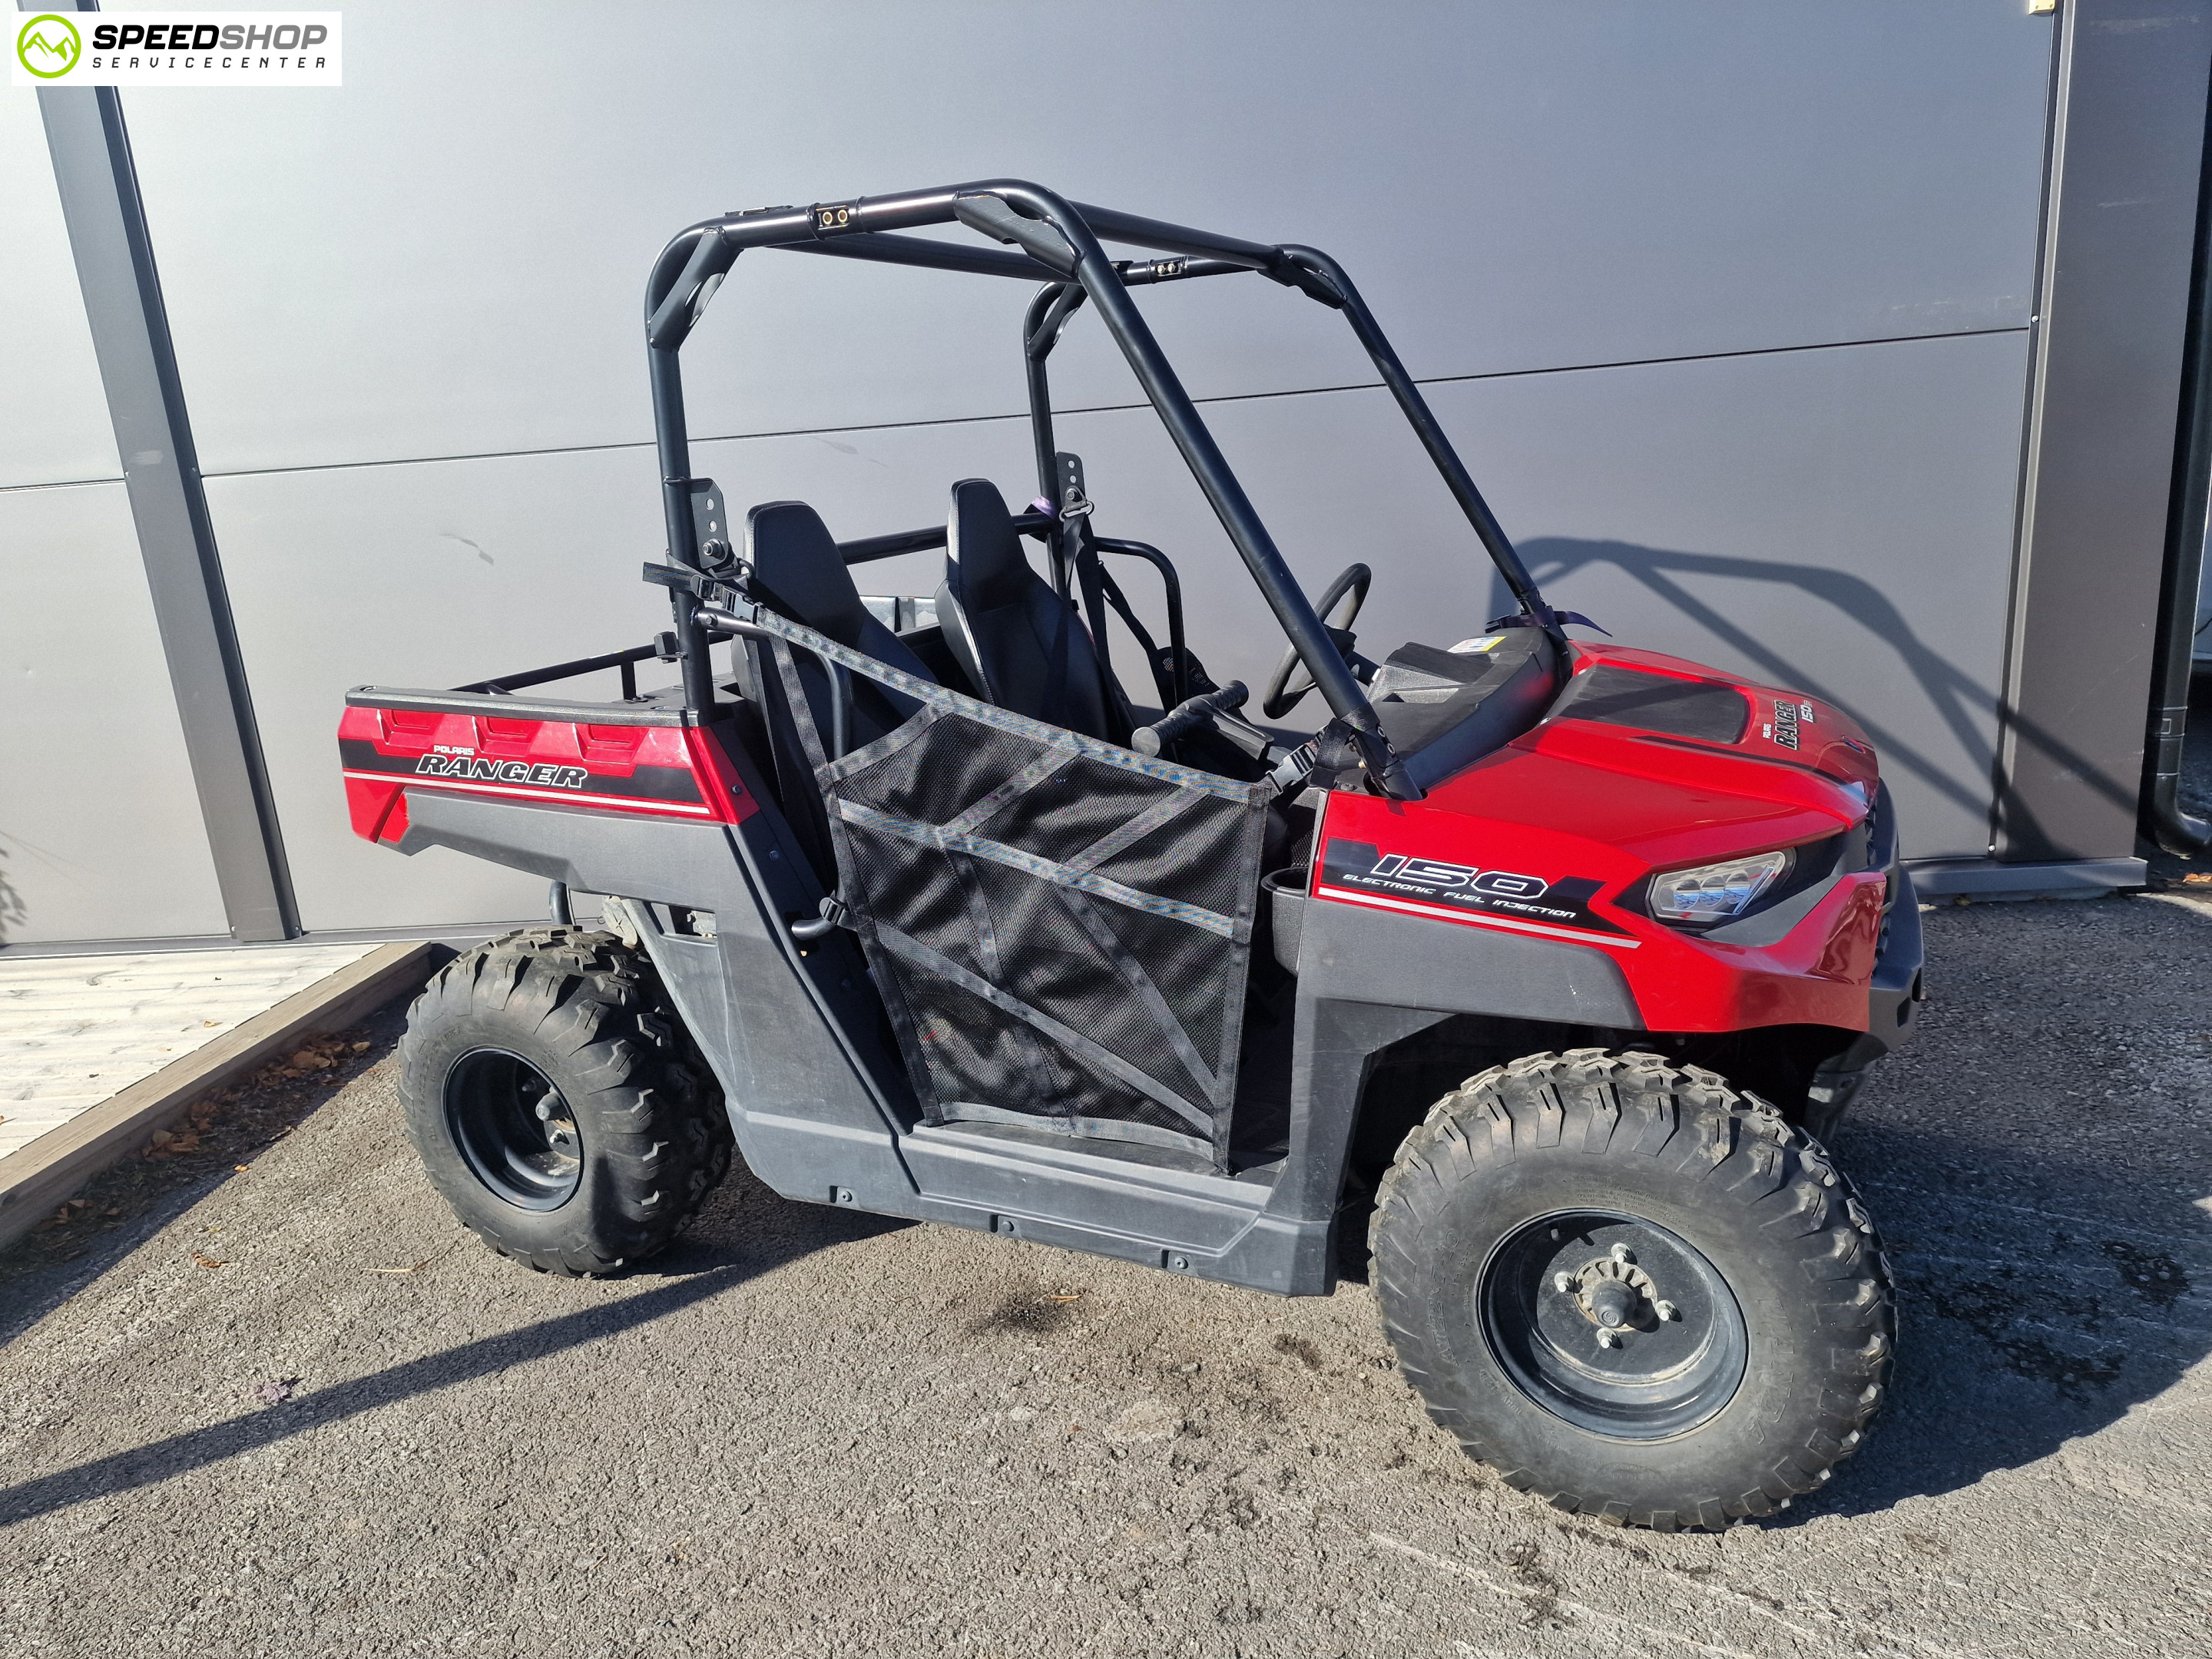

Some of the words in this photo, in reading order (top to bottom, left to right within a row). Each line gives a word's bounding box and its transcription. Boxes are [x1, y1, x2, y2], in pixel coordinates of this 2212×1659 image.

[1774, 700, 1797, 750] RANGER
[416, 754, 588, 788] RANGER
[433, 744, 475, 756] POLARIS
[1343, 873, 1436, 895] ELECTRONIC
[1443, 891, 1485, 904] FUEL
[1493, 899, 1577, 918] INJECTION
[1370, 853, 1549, 899] 150
